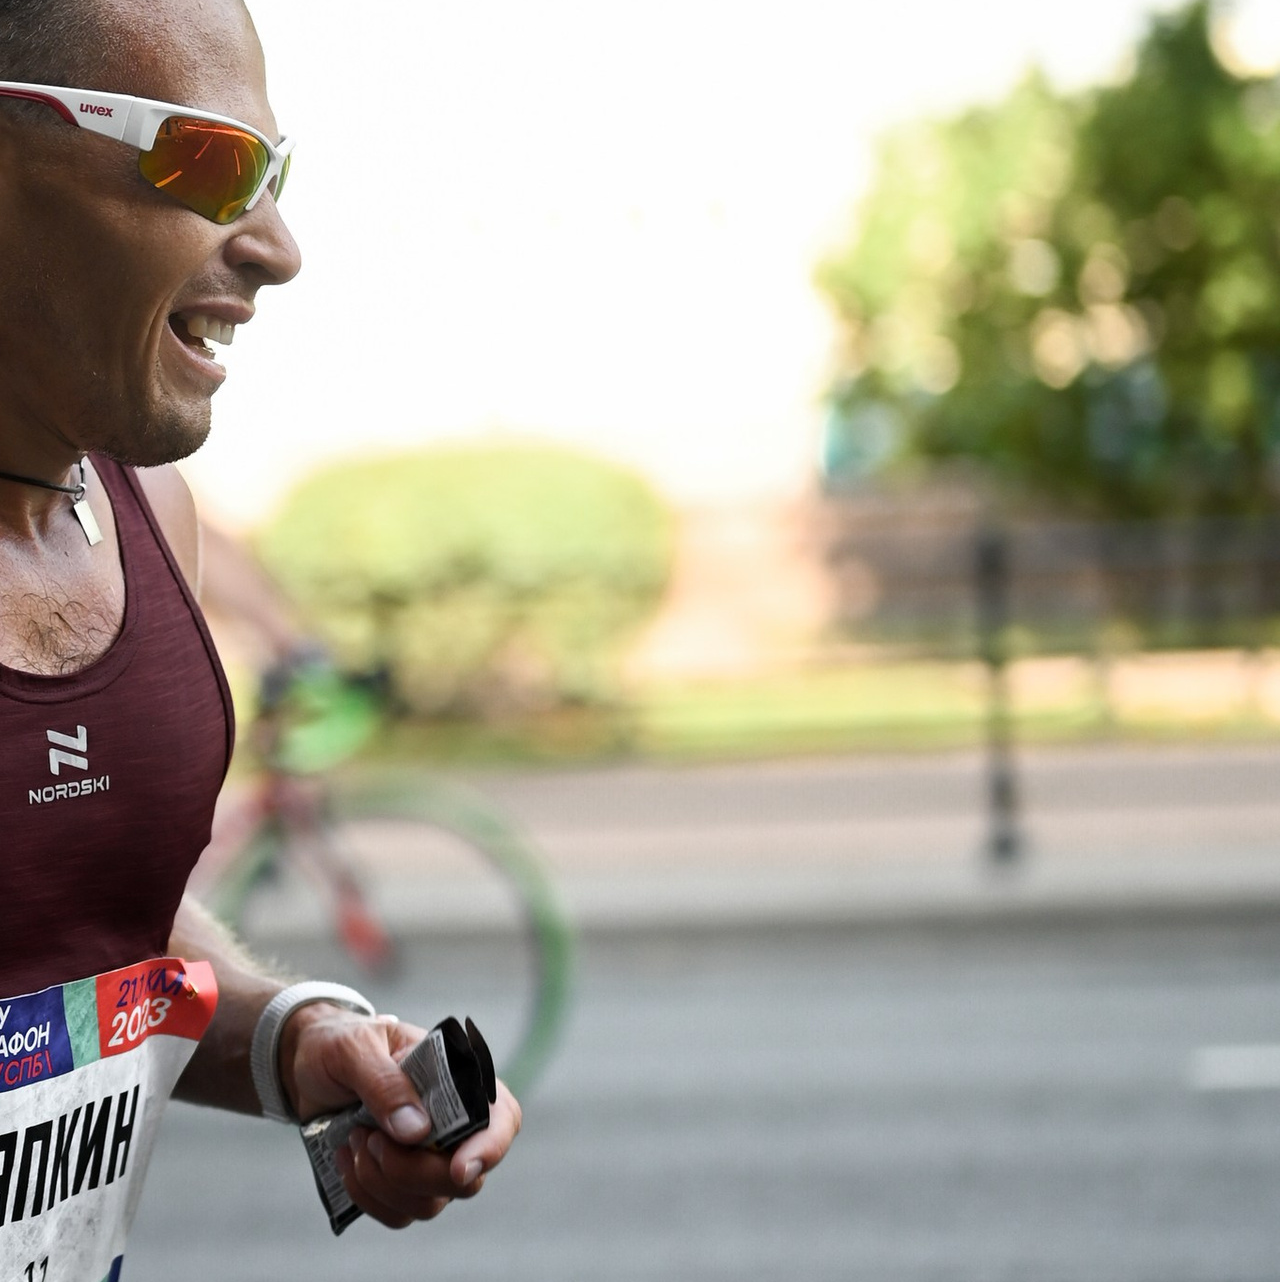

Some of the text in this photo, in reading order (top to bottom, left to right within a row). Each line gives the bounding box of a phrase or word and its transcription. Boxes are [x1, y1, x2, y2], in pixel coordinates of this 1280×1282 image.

[79, 103, 114, 118] uvex
[28, 775, 110, 805] NORDSKI
[107, 997, 173, 1048] 2023
